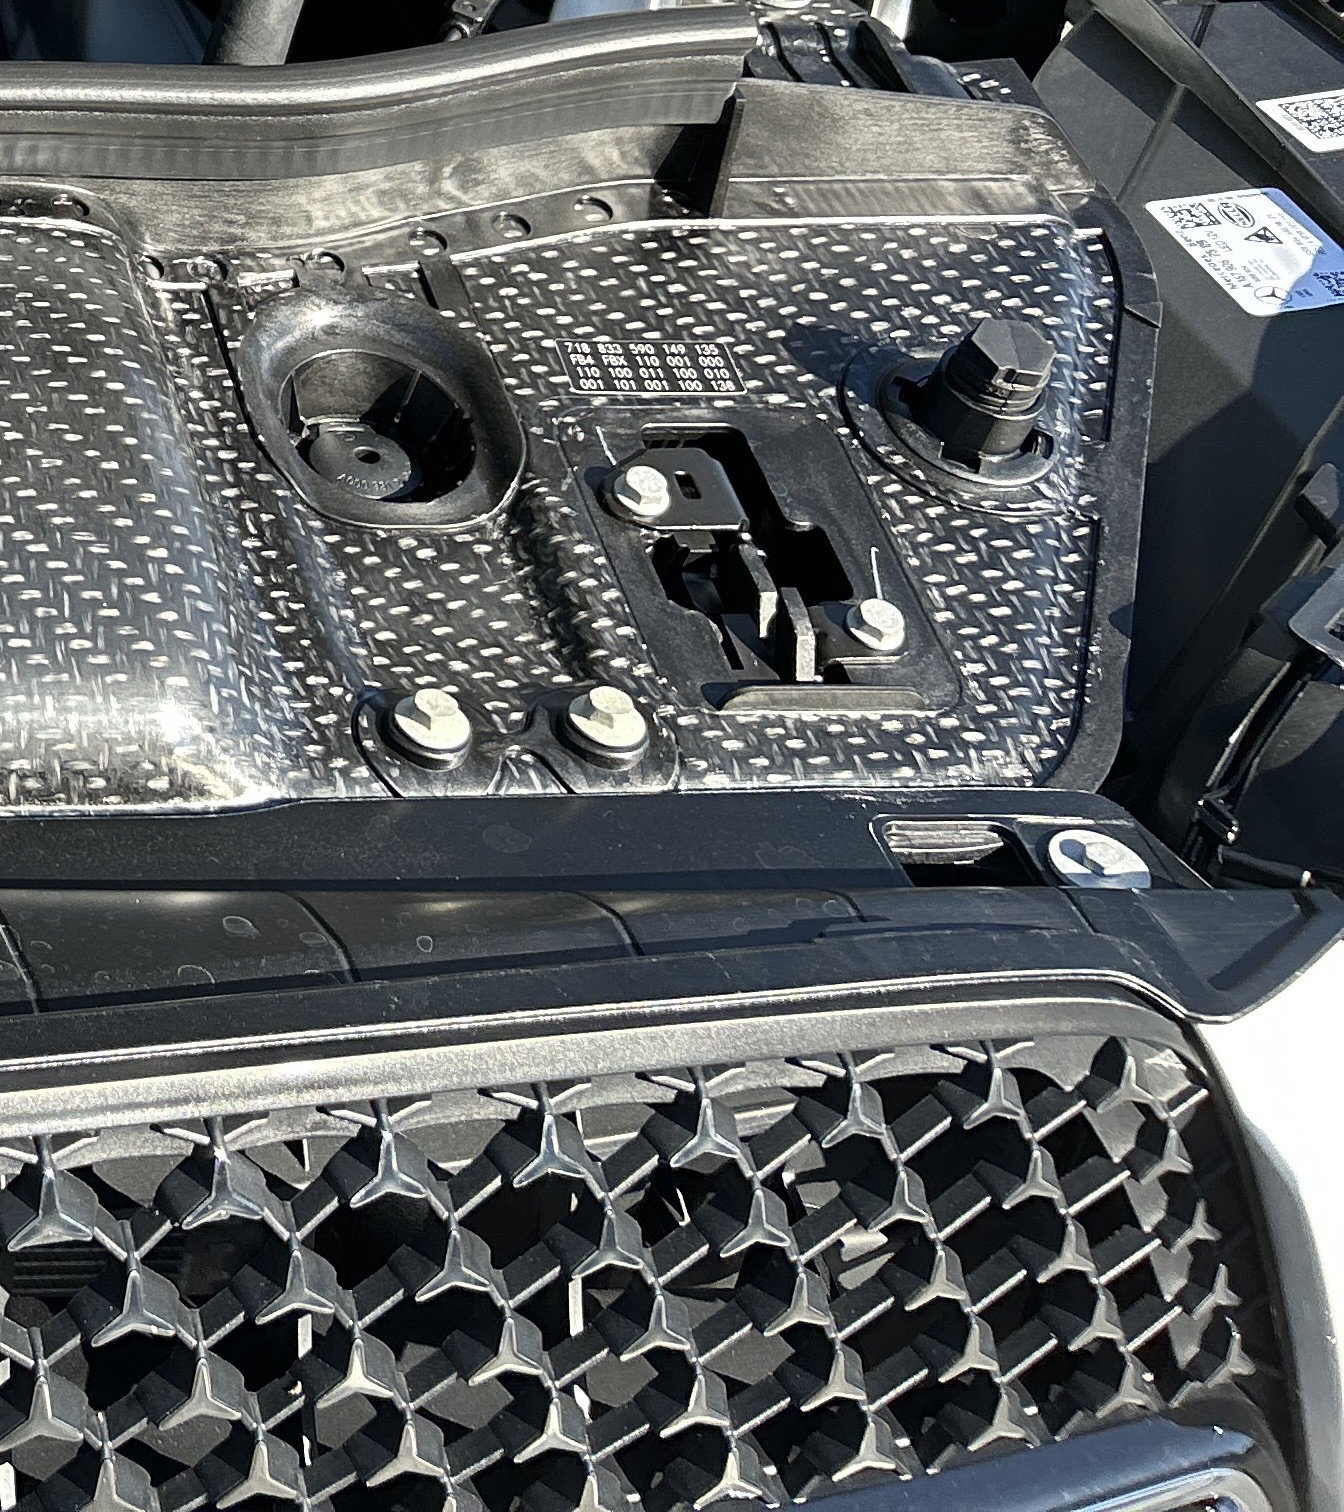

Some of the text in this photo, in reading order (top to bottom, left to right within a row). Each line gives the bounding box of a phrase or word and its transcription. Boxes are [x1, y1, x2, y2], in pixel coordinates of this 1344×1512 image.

[564, 342, 719, 356] 718 833 590 149 135
[570, 354, 724, 368] FB4 FBX 110 001 000
[576, 366, 730, 380] 110 100 011 100 010
[580, 378, 736, 392] 001 101 001 100 138
